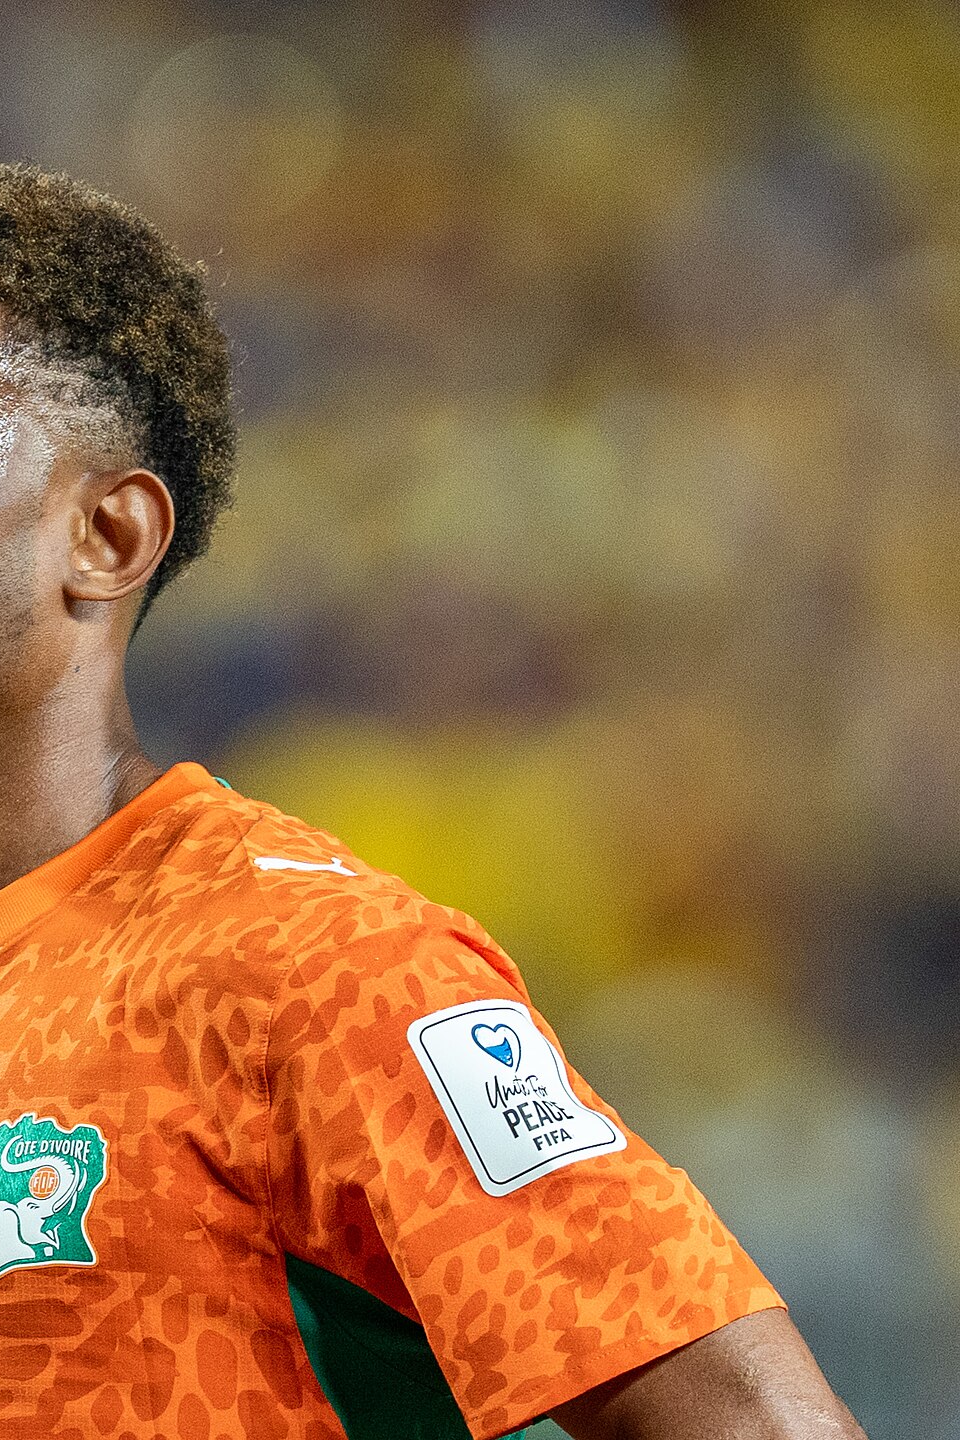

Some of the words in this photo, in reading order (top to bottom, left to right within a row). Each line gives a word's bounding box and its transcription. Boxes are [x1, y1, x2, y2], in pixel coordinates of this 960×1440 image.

[502, 1100, 574, 1139] PEACE
[532, 1127, 573, 1151] FIFA
[40, 1140, 91, 1165] D'IVOIRE
[33, 1176, 55, 1189] FIF
